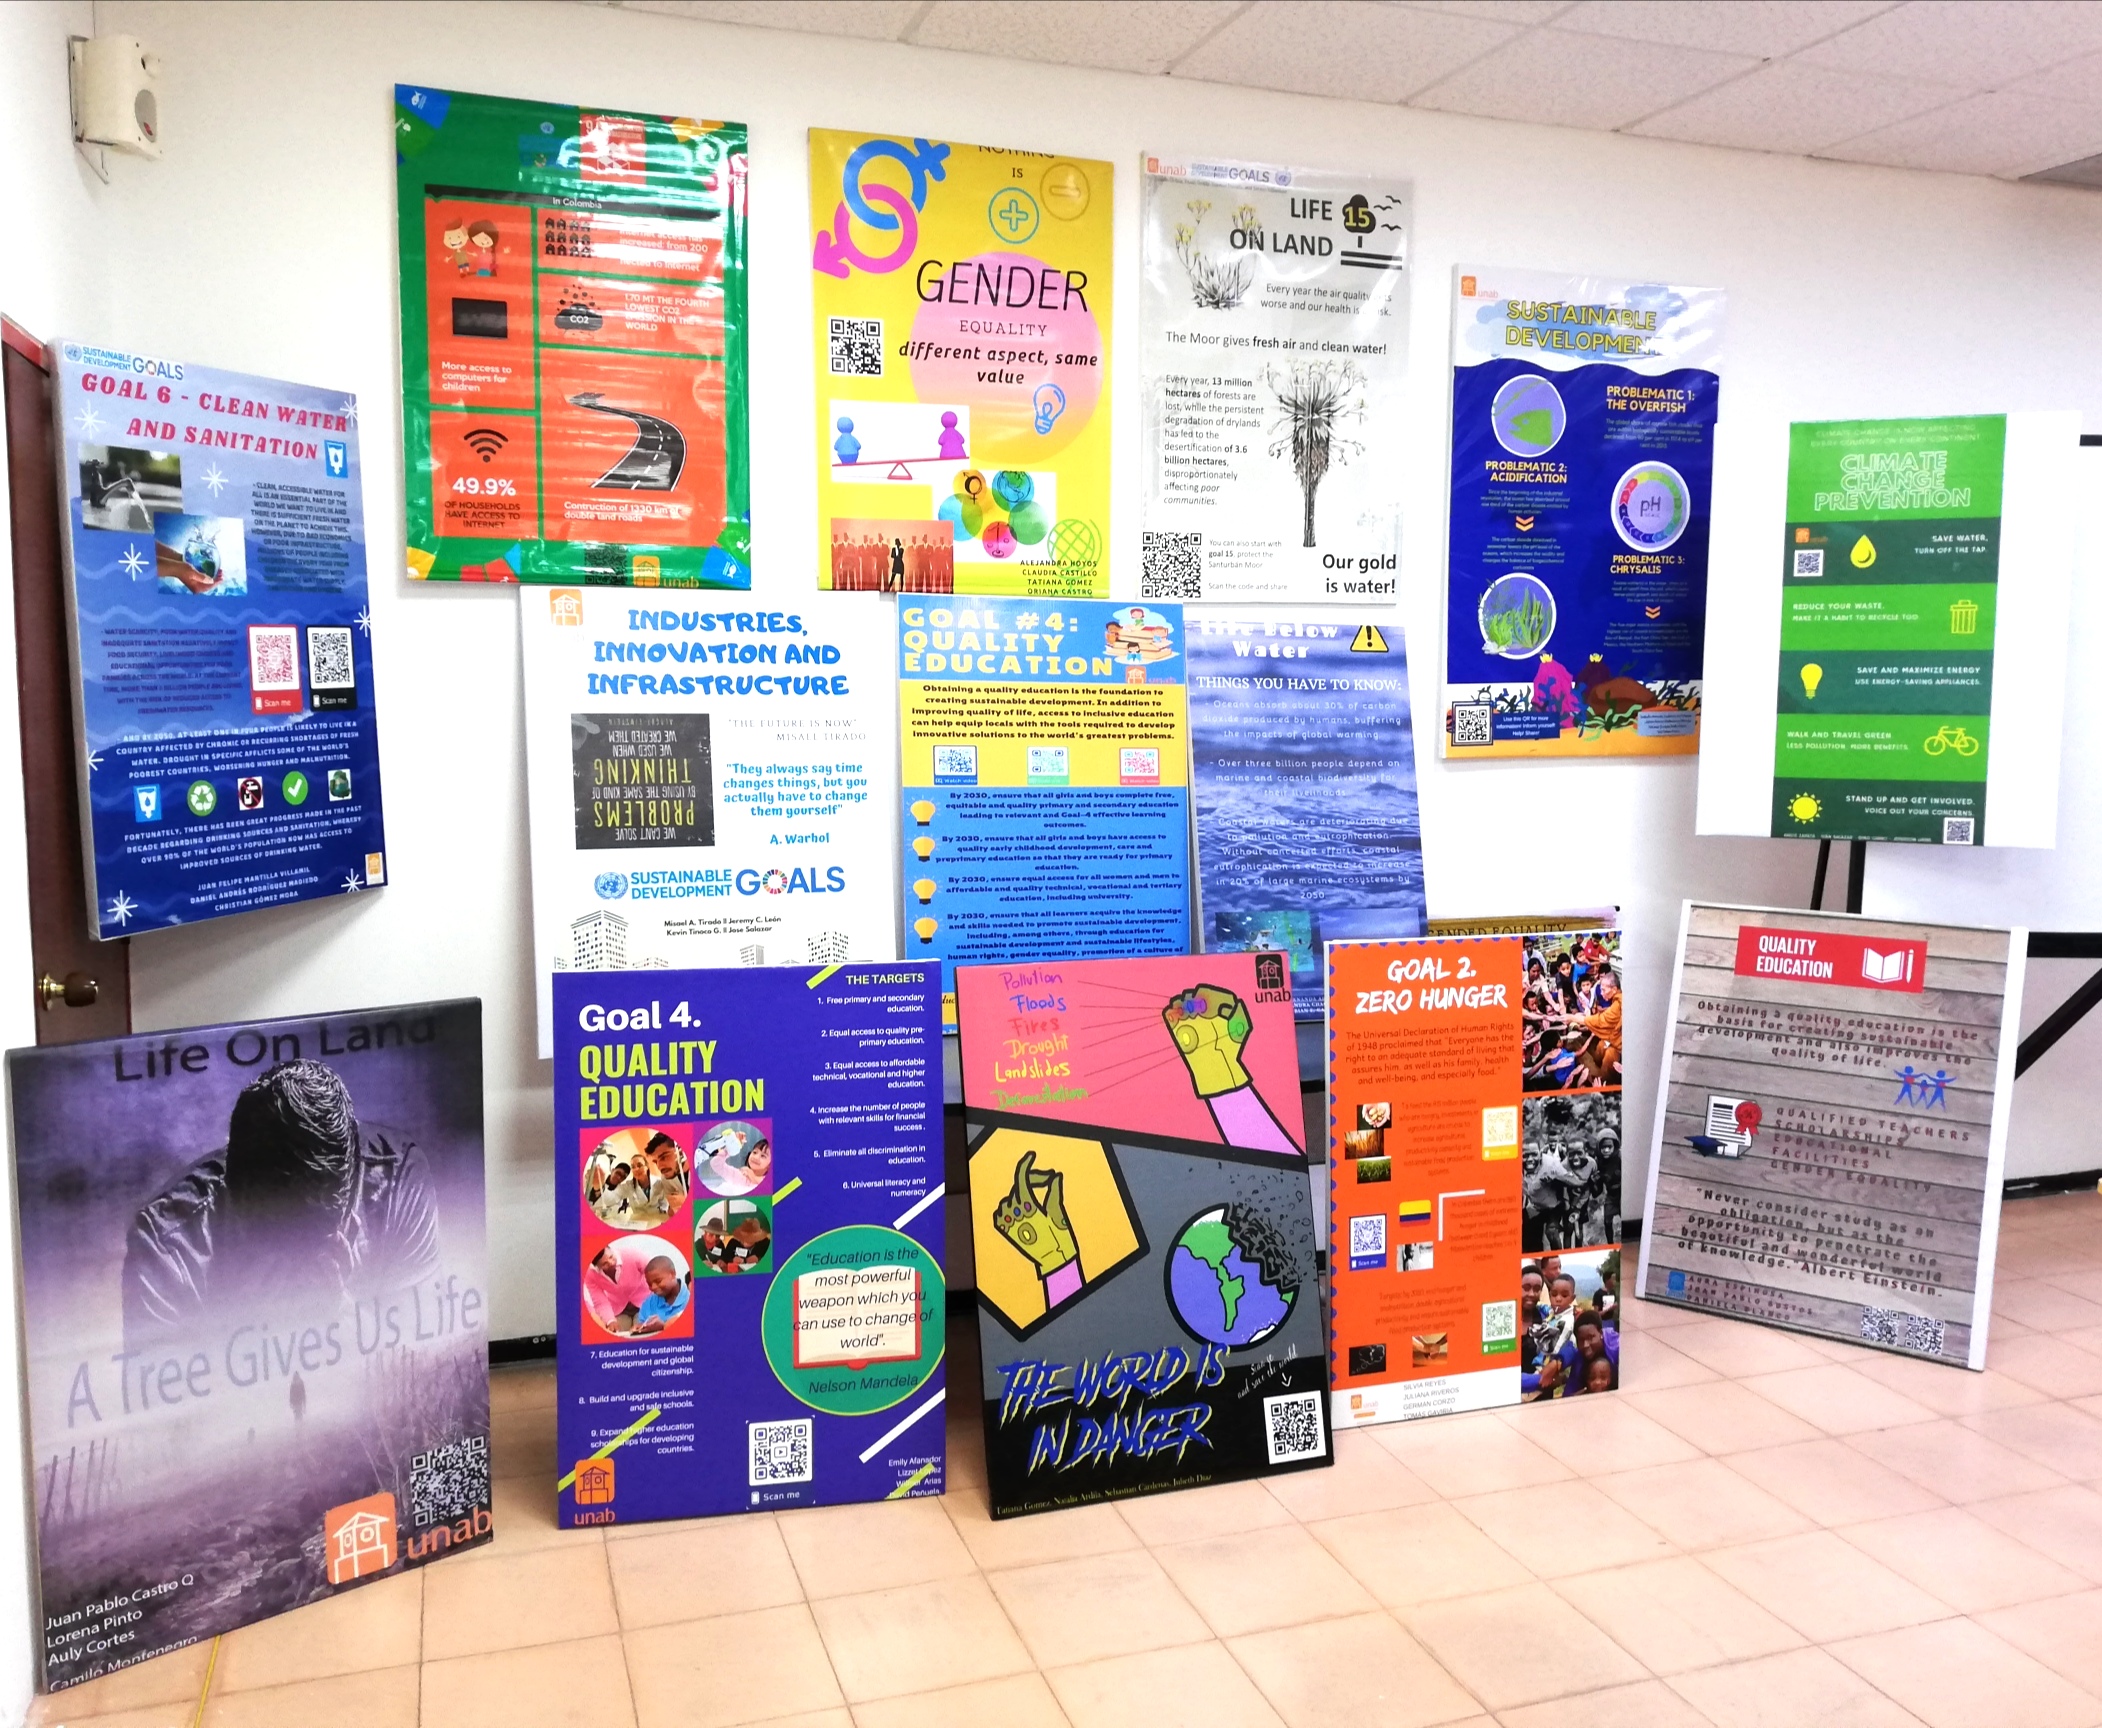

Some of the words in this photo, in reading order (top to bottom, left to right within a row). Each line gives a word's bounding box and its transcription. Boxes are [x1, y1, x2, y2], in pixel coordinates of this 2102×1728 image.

[1012, 168, 1023, 178] IS
[1159, 164, 1186, 176] unab
[1228, 168, 1270, 183] GOALS
[552, 198, 560, 206] In
[563, 198, 602, 209] Colombia
[1290, 198, 1332, 221] LIFE
[1344, 207, 1370, 227] 15
[1230, 228, 1264, 251] ON
[1272, 232, 1333, 257] LAND
[916, 259, 1089, 312] GENDER
[1478, 290, 1499, 298] unab
[570, 315, 589, 325] CO2
[1507, 300, 1657, 330] SUSTAINABLE
[960, 320, 1048, 336] EQUALITY
[1166, 331, 1186, 343] The
[1189, 333, 1220, 345] Moor
[1223, 335, 1250, 347] gives
[1252, 336, 1280, 349] fresh
[1282, 338, 1297, 349] air
[1299, 340, 1318, 351] and
[1321, 341, 1349, 352] clean
[1352, 343, 1387, 354] water!
[1506, 326, 1664, 355] DEVELOPMEN
[82, 346, 131, 363] SUSTAINABLE
[83, 357, 131, 371] DEVELOPMENT
[899, 342, 980, 361] different
[987, 348, 1049, 366] aspect,
[1054, 352, 1098, 366] same
[133, 357, 184, 380] GOALS
[442, 361, 466, 371] More
[469, 364, 500, 373] access
[977, 370, 1024, 384] value
[442, 373, 490, 384] computers
[493, 375, 507, 383] for
[442, 382, 480, 392] children
[81, 372, 148, 400] GOAL
[157, 386, 171, 404] 6
[199, 392, 269, 419] CLEAN
[277, 405, 347, 432] WATER
[1606, 385, 1684, 400] PROBLEMATIC
[1687, 390, 1695, 401] 1:
[1606, 398, 1627, 410] THE
[1629, 400, 1686, 413] OVERFISH
[126, 418, 176, 440] AND
[184, 426, 318, 460] SANITATION
[1485, 461, 1556, 472] PROBLEMATIC
[1558, 462, 1568, 473] 2:
[1840, 450, 1948, 473] CLIMATE
[452, 477, 516, 496] 49.9%
[1490, 472, 1568, 483] ACIDIFICATION
[1840, 470, 1946, 492] CHANGE
[1639, 496, 1661, 518] pH
[1814, 488, 1972, 511] PREVENTION
[1322, 554, 1354, 569] Our
[1358, 554, 1397, 573] gold
[1610, 565, 1662, 574] CHRYSALIS
[1612, 555, 1676, 564] PROBLEMATIC
[1678, 556, 1686, 565] 3:
[663, 578, 699, 589] unab
[1326, 578, 1338, 593] is
[1344, 578, 1396, 593] water!
[627, 609, 808, 636] INDUSTRIES,
[903, 607, 1000, 629] GOAL
[1015, 612, 1078, 632] #4:
[593, 641, 777, 665] INNOVATION
[784, 644, 841, 665] AND
[903, 631, 1065, 654] QUALITY
[1232, 641, 1310, 658] Water
[904, 654, 1113, 676] EDUCATION
[587, 673, 850, 696] INFRASTRUCTURE
[1196, 676, 1249, 689] THINGS
[1253, 678, 1283, 689] YOU
[1288, 678, 1327, 690] HAVE
[1330, 680, 1349, 690] TO
[1354, 680, 1402, 691] KNOW:
[931, 719, 953, 729] help
[955, 720, 983, 730] equip
[985, 720, 1014, 728] locals
[1016, 720, 1038, 728] with
[1083, 721, 1124, 730] required
[1138, 722, 1175, 730] develop
[594, 758, 692, 785] THINKING
[594, 800, 695, 828] PROBLEMS
[769, 834, 783, 844] A.
[785, 832, 830, 844] Warhol
[630, 869, 733, 885] SUSTAINABLE
[735, 866, 846, 895] GOALS
[631, 884, 732, 899] DEVELOPMENT
[1300, 891, 1325, 899] 2050
[1759, 935, 1817, 955] QUALITY
[1387, 957, 1452, 984] GOAL
[1456, 956, 1477, 979] 2.
[1756, 956, 1834, 979] EDUCATION
[845, 974, 870, 985] THE
[873, 973, 925, 984] TARGETS
[999, 968, 1063, 992] Pollution
[1009, 994, 1067, 1014] Floods
[1254, 988, 1292, 1003] unab
[1355, 990, 1413, 1014] ZERO
[1420, 984, 1508, 1010] HUNGER
[578, 1000, 662, 1032] Goal
[669, 1001, 702, 1029] 4.
[1008, 1016, 1061, 1036] Fires
[113, 1044, 211, 1083] Life
[226, 1029, 301, 1068] On
[318, 1016, 437, 1057] Land
[1003, 1034, 1069, 1059] Drought
[578, 1040, 717, 1083] QUALITY
[994, 1061, 1071, 1082] Landslides
[579, 1079, 765, 1121] EDUCATION
[884, 1250, 895, 1261] is
[896, 1247, 919, 1261] the
[814, 1272, 849, 1288] most
[851, 1268, 912, 1287] powerful
[799, 1294, 855, 1312] weapon
[857, 1291, 899, 1305] which
[900, 1289, 927, 1305] you
[793, 1317, 820, 1332] can
[822, 1318, 846, 1330] use
[848, 1315, 862, 1328] to
[864, 1312, 916, 1329] change
[919, 1309, 933, 1322] of
[66, 1361, 102, 1430] A
[111, 1350, 212, 1415] Tree
[225, 1322, 343, 1389] Gives
[354, 1298, 401, 1356] Us
[414, 1274, 483, 1342] Life
[808, 1378, 857, 1395] Nelson
[859, 1374, 919, 1389] Mandela
[996, 1358, 1074, 1428] THE
[1072, 1346, 1192, 1414] WORLD
[1195, 1342, 1231, 1392] IS
[1028, 1408, 1072, 1477] IN
[1058, 1399, 1215, 1474] DANGER
[763, 1492, 785, 1501] Scan
[787, 1492, 800, 1500] me
[574, 1508, 616, 1526] unab
[406, 1507, 493, 1560] unab
[46, 1610, 84, 1632] Juan
[85, 1594, 129, 1619] Pablo
[131, 1579, 180, 1603] Castro
[181, 1574, 194, 1588] Q
[47, 1645, 84, 1667] Auly
[84, 1628, 136, 1655] Cortes
